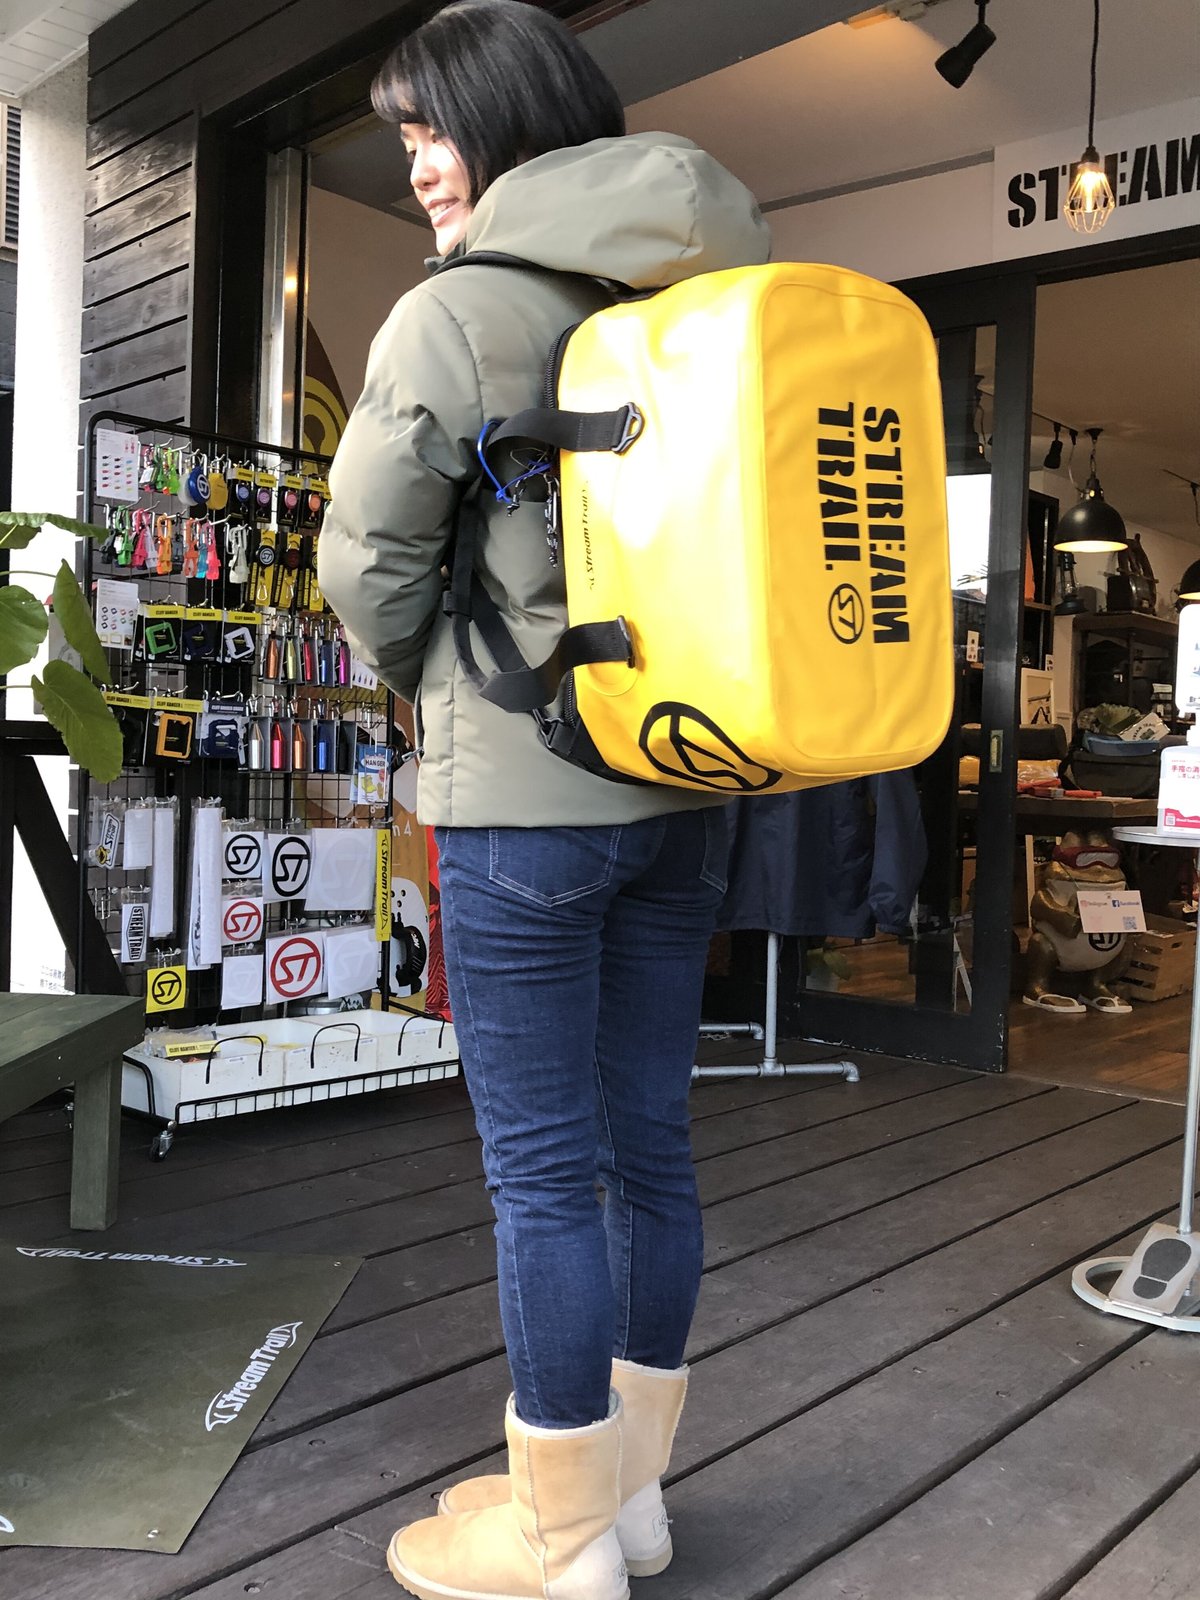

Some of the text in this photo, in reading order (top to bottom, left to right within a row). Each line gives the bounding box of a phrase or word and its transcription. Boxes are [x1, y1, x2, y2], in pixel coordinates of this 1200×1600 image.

[863, 406, 909, 643] STREAM
[381, 849, 389, 916] Stream Trail
[128, 908, 144, 959] STREAM TRAIL
[46, 1249, 211, 1265] Stream Trail
[216, 1332, 290, 1412] Stream Trail
